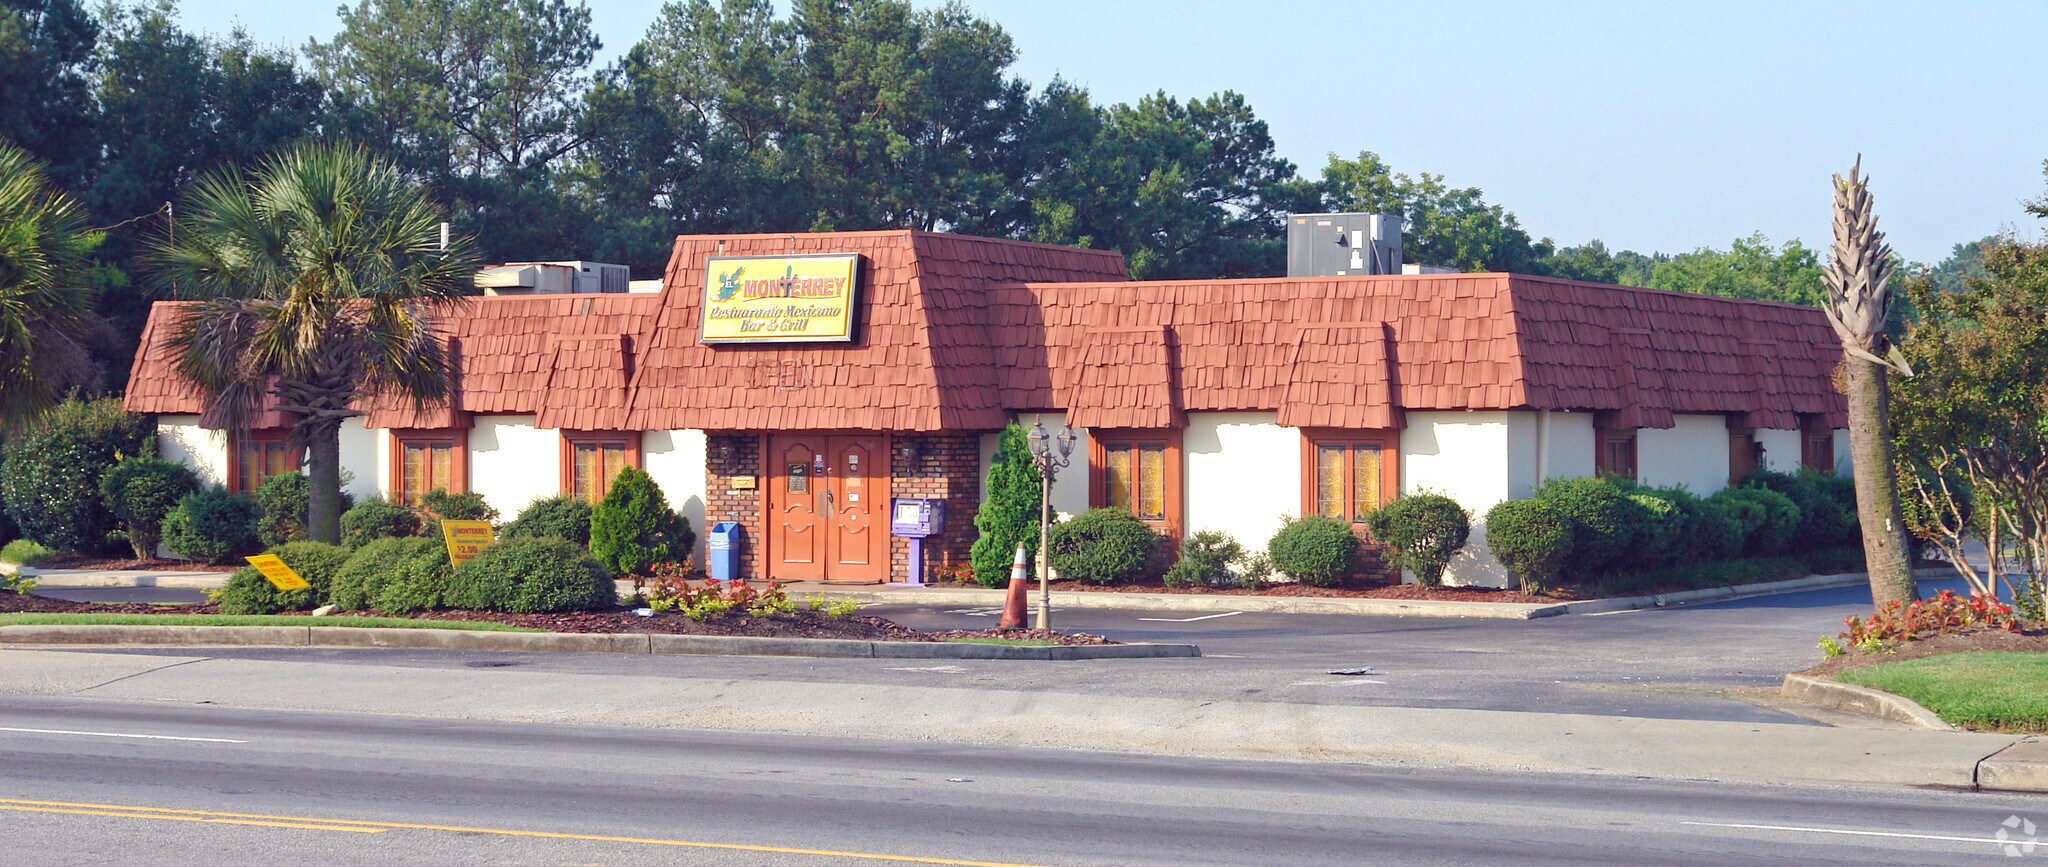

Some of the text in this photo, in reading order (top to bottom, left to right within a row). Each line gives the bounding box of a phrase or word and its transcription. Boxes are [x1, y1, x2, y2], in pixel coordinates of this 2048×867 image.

[743, 276, 846, 297] MONTERREY
[784, 304, 841, 318] Mexicano
[741, 318, 809, 332] Bar & Grill
[456, 527, 487, 535] MONTERREY
[457, 545, 478, 553] $2.00
